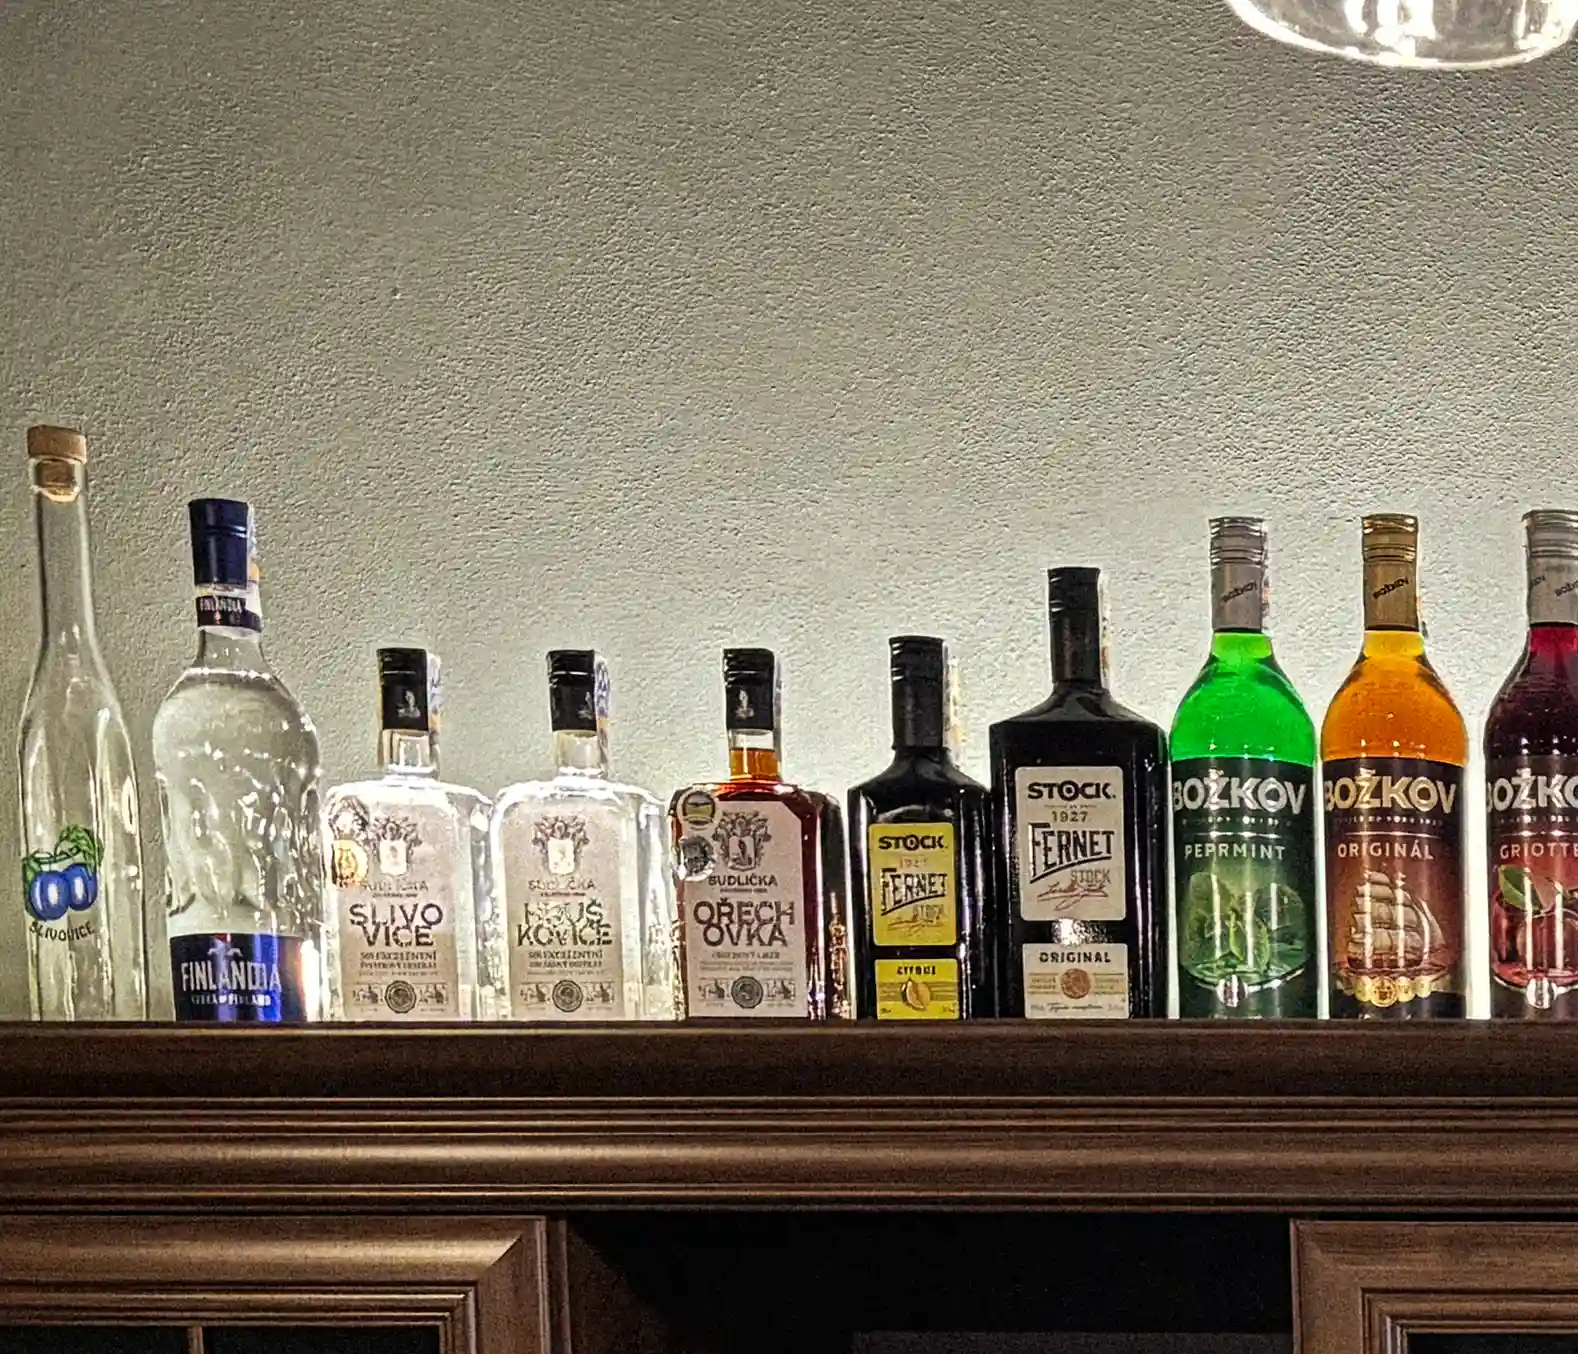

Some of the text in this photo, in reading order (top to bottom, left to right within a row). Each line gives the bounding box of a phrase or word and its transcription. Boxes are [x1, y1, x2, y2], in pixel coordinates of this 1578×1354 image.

[1173, 768, 1307, 814] BOŽKOV
[1325, 768, 1457, 814] BOŽKOV
[1052, 811, 1088, 822] 1927
[1028, 823, 1115, 878] FERNET
[1185, 842, 1286, 860] PEPRMINT
[1338, 839, 1434, 860] ORIGINÁL
[1070, 869, 1111, 884] STOCK
[880, 868, 947, 911] FERNET
[349, 903, 444, 926] SLIVO
[693, 897, 795, 925] OŘECH
[361, 924, 434, 948] VICE
[517, 924, 612, 947] KOVICE
[703, 924, 788, 947] OVKA
[1039, 951, 1111, 963] ORIGINAL
[181, 962, 282, 992] FINLANDIA
